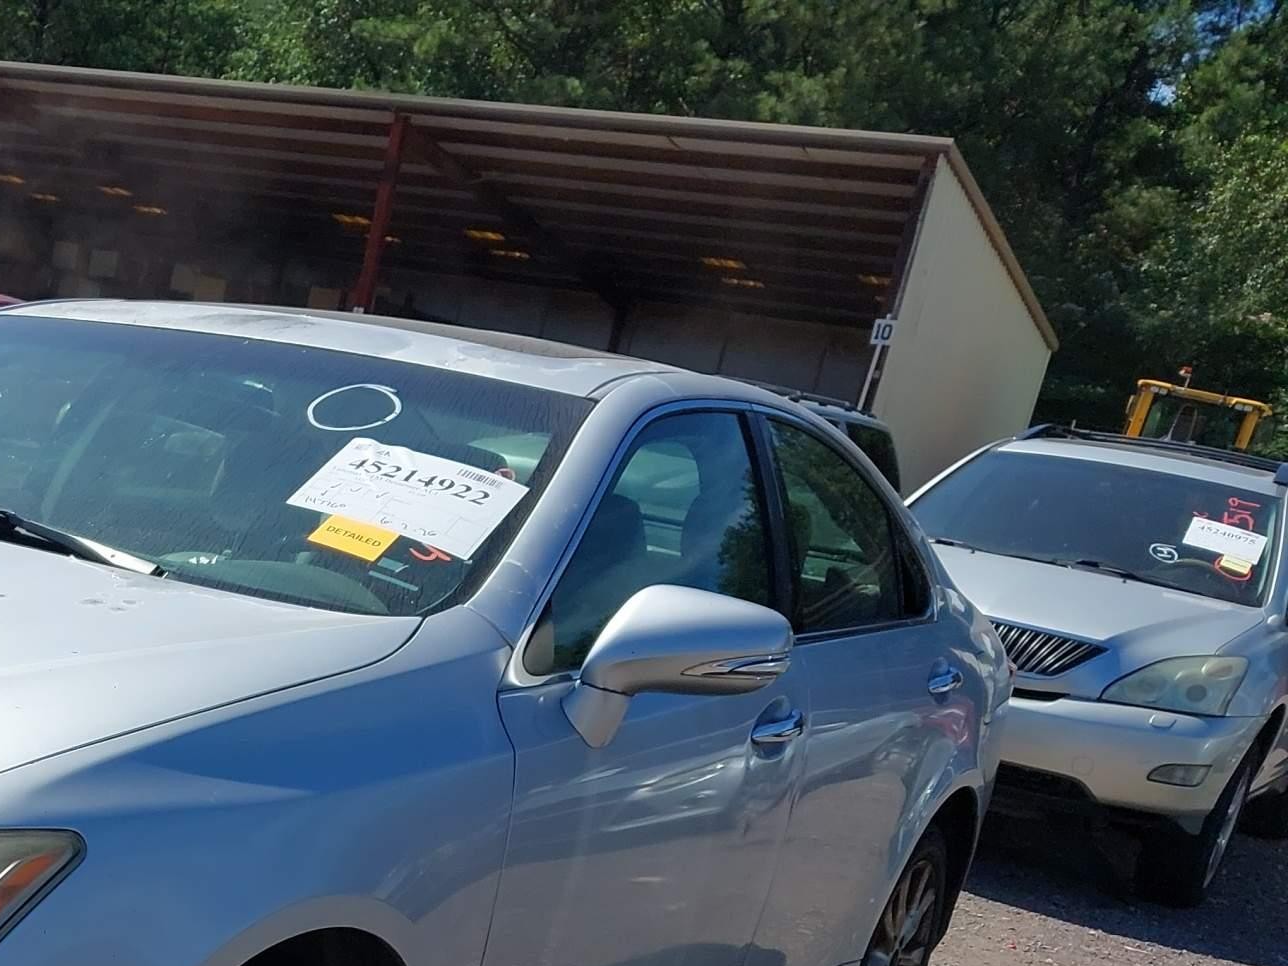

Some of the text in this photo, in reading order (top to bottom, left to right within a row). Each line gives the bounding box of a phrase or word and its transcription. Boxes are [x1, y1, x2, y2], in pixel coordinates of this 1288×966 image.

[874, 323, 893, 340] 10
[348, 457, 491, 506] 45214922
[326, 524, 383, 549] DETAILED
